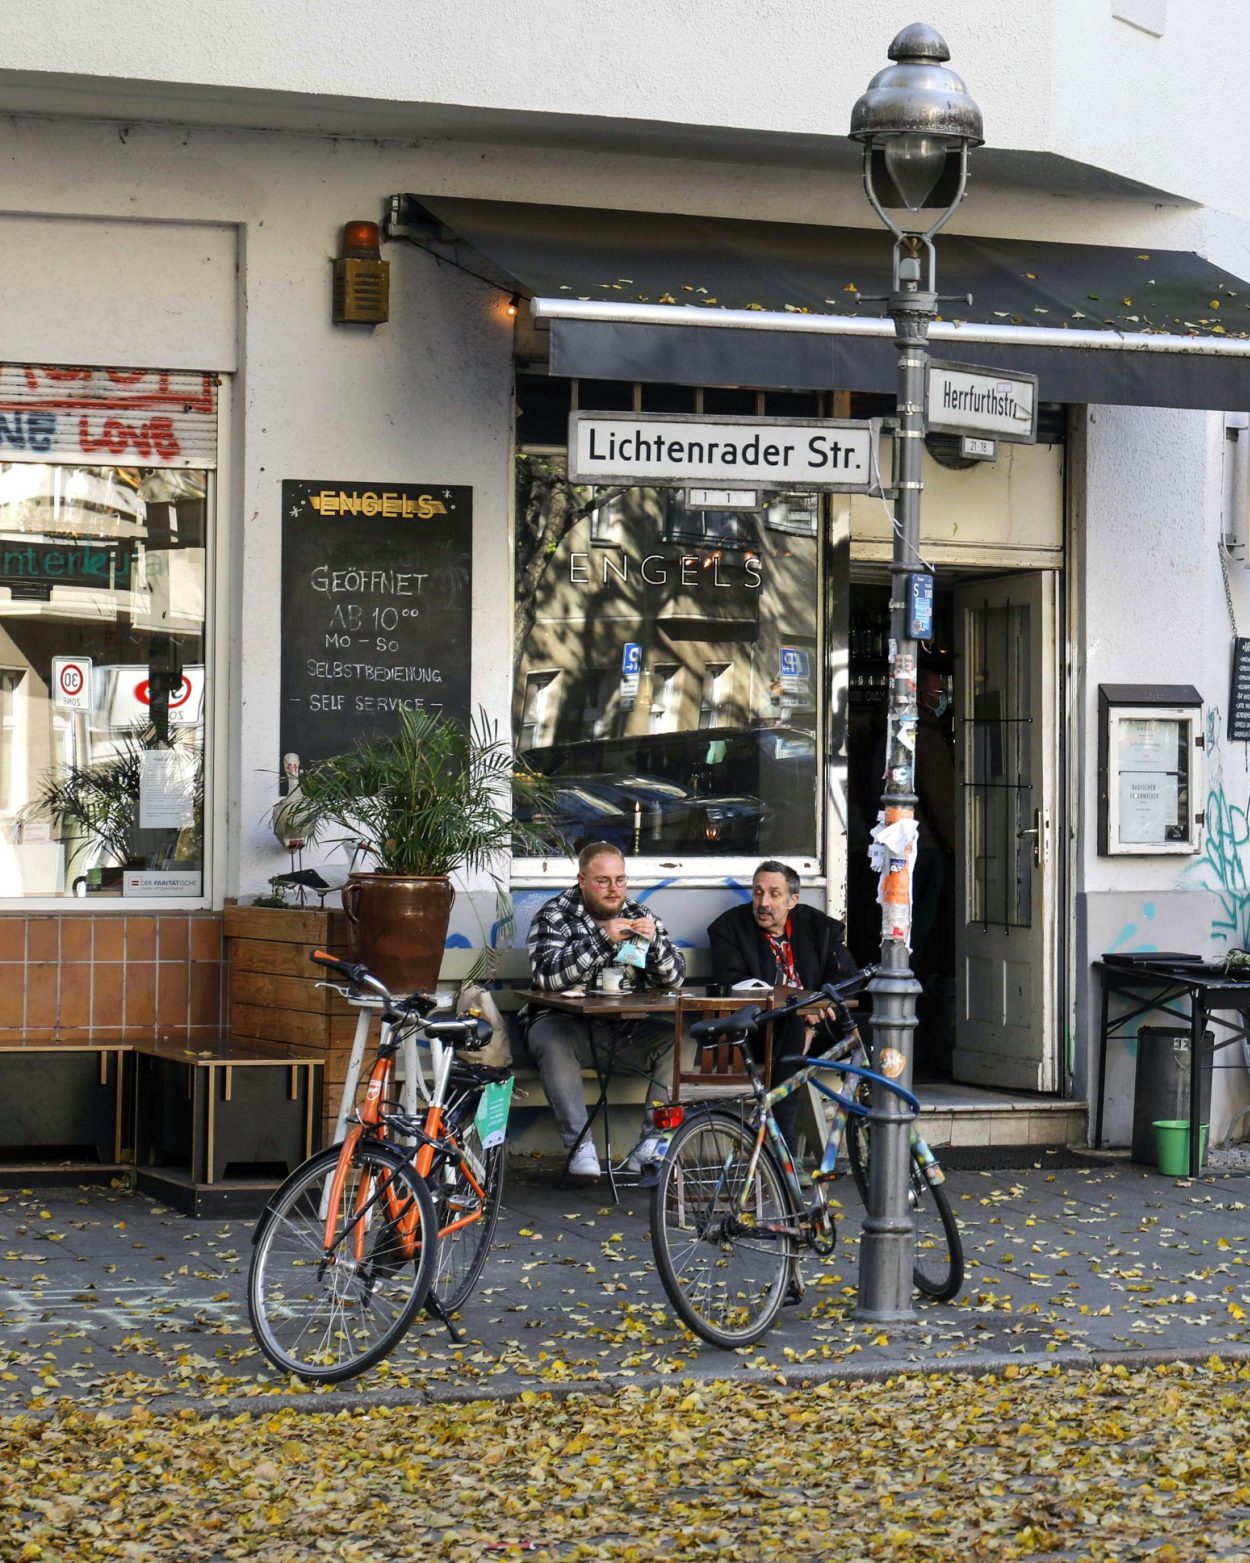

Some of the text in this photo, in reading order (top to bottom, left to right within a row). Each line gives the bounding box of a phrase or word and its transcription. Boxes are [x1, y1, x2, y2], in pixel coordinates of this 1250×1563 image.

[588, 428, 862, 470] Lichtenrader Str.
[319, 490, 435, 519] ENGELS
[310, 564, 429, 599] GEÖFFNET
[569, 552, 763, 589] ENGELS
[913, 583, 919, 597] S
[329, 604, 363, 631] AB
[325, 633, 351, 649] MO
[376, 637, 399, 652] SO
[306, 658, 443, 683] SELBSTBEDIENUNG
[309, 693, 424, 713] SELF SERVICE
